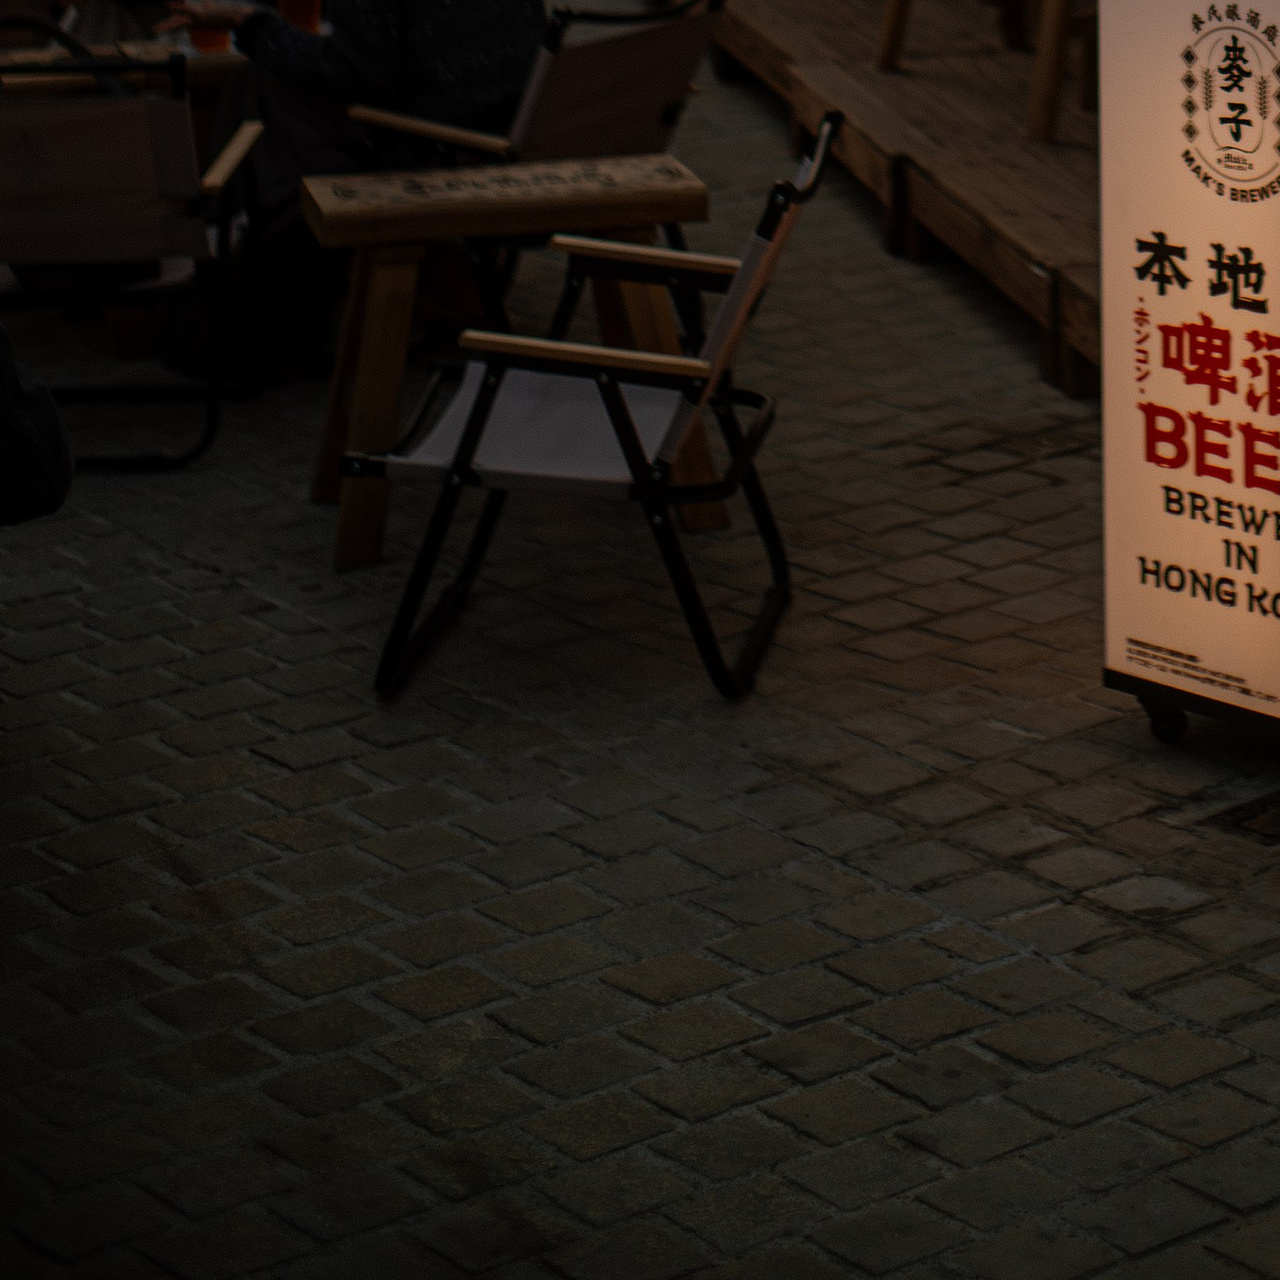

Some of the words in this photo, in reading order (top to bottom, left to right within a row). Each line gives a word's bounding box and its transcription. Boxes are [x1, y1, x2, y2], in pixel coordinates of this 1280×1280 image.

[1181, 148, 1226, 197] MAK'S
[1222, 538, 1259, 575] IN
[1137, 555, 1238, 608] HONG
